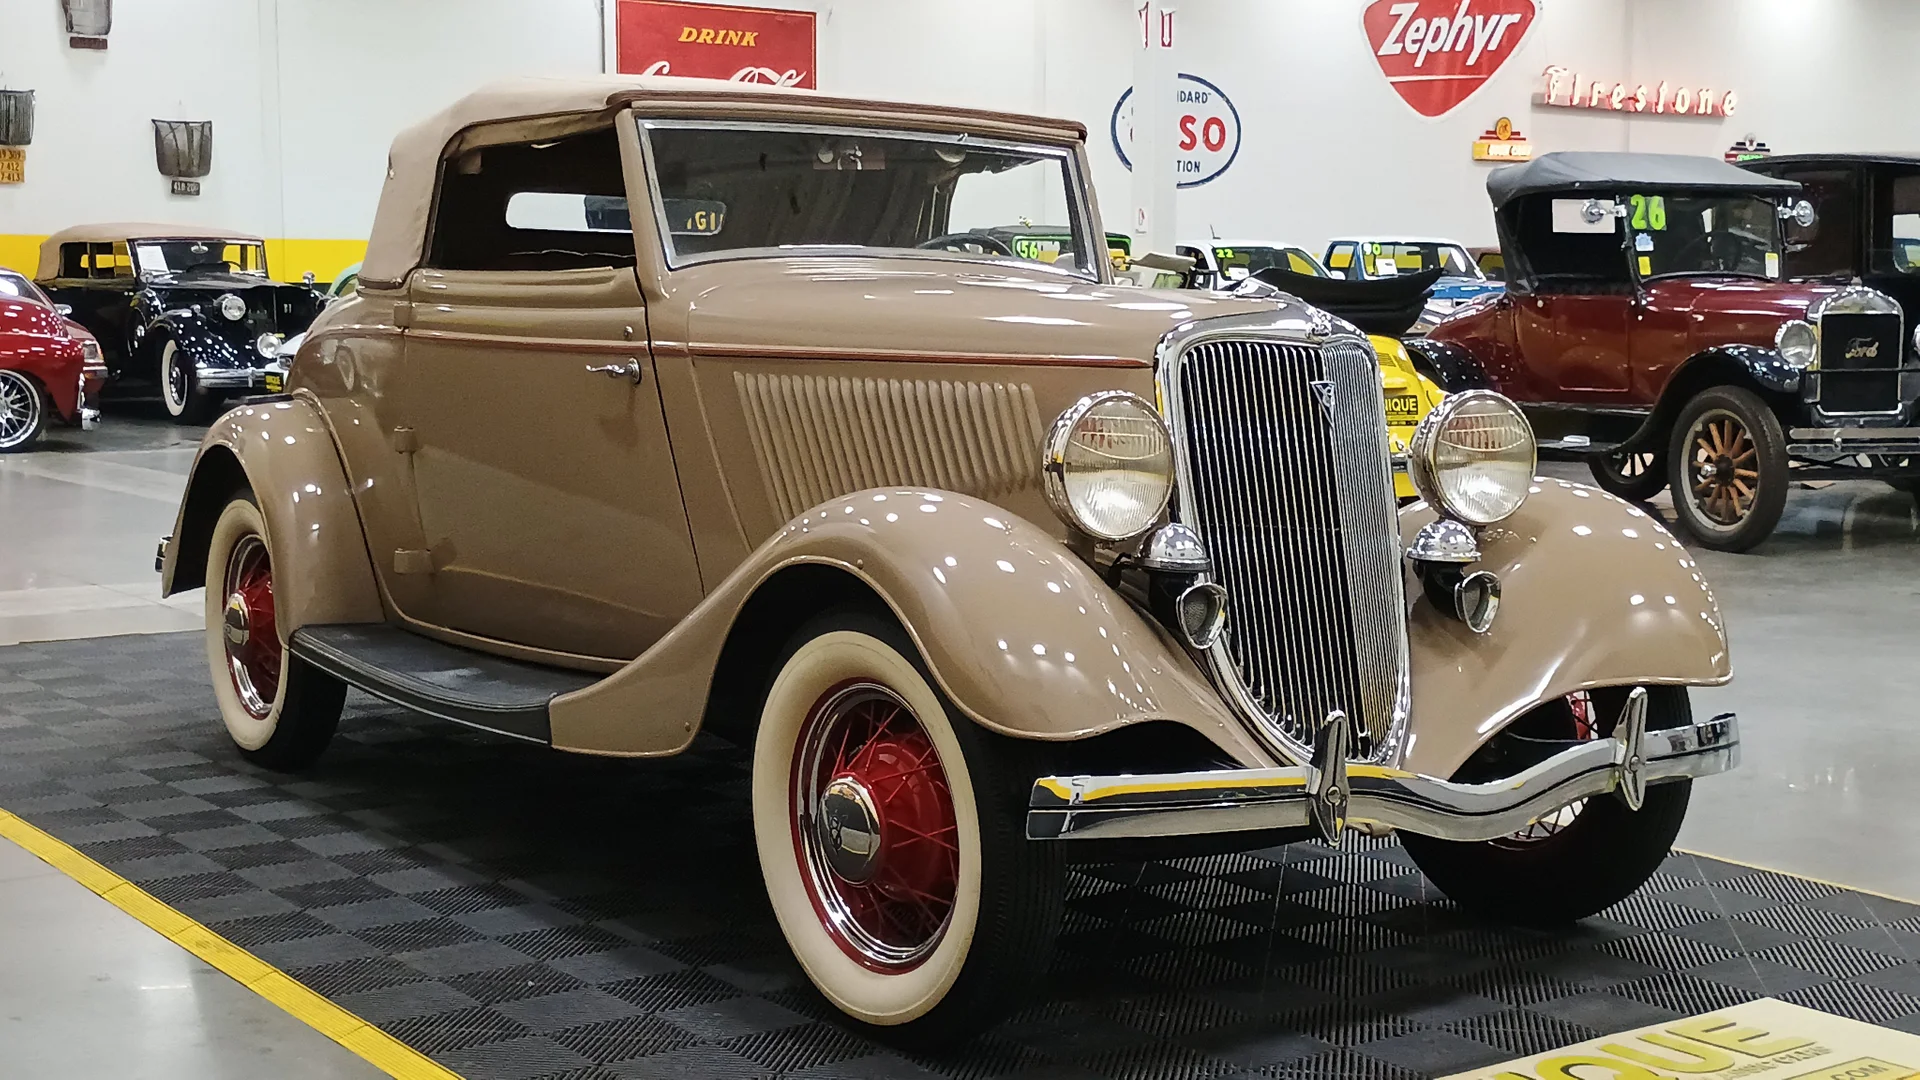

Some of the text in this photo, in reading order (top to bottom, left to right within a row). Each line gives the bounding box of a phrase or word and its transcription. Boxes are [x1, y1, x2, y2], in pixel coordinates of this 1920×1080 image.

[678, 27, 759, 46] DRINK
[1377, 0, 1522, 67] Zephyr
[1543, 65, 1737, 117] Firestone
[1630, 194, 1666, 230] 26
[1020, 240, 1039, 259] 56
[1215, 248, 1235, 259] 22
[1845, 337, 1879, 359] Ford
